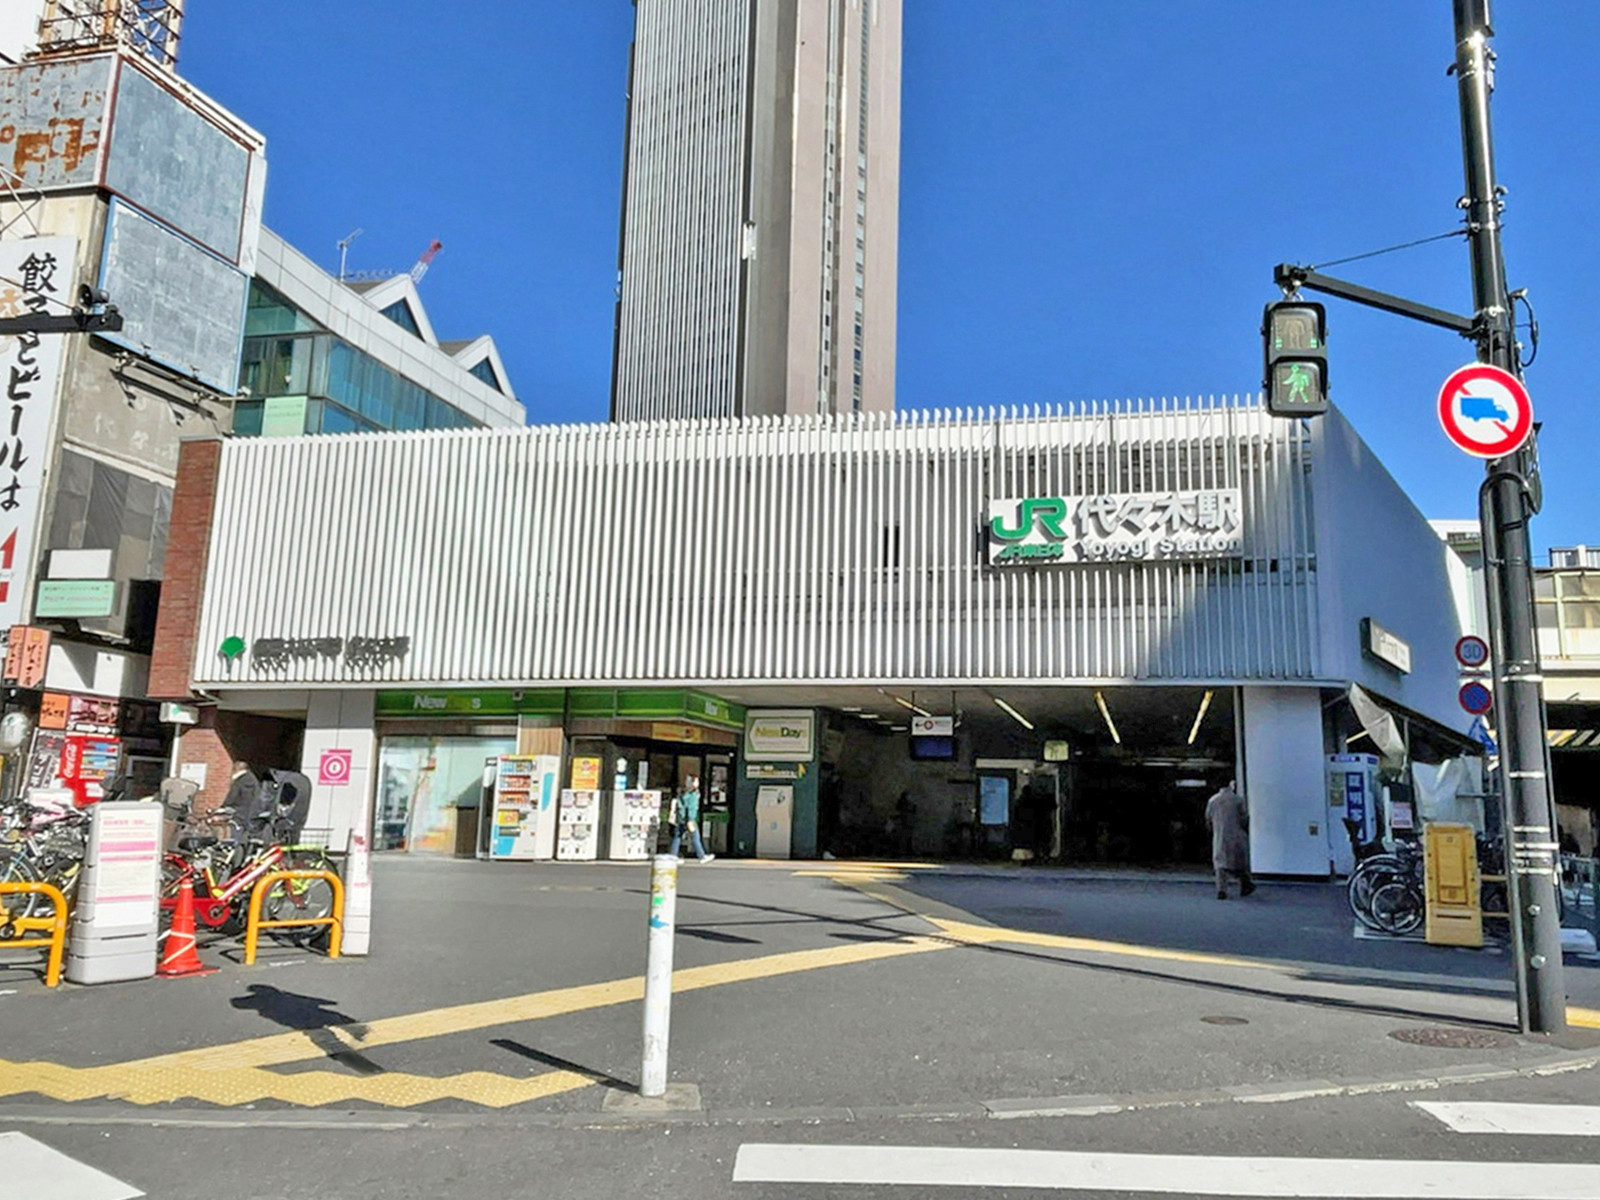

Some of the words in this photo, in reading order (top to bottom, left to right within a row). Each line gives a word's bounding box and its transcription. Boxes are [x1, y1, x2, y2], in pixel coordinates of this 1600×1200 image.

[992, 497, 1069, 540] JR
[1078, 490, 1239, 534] 代々木駅
[999, 542, 1064, 559] JR東日本
[1082, 538, 1150, 558] Yoyogi
[1159, 537, 1241, 554] Station
[1462, 643, 1482, 659] 30
